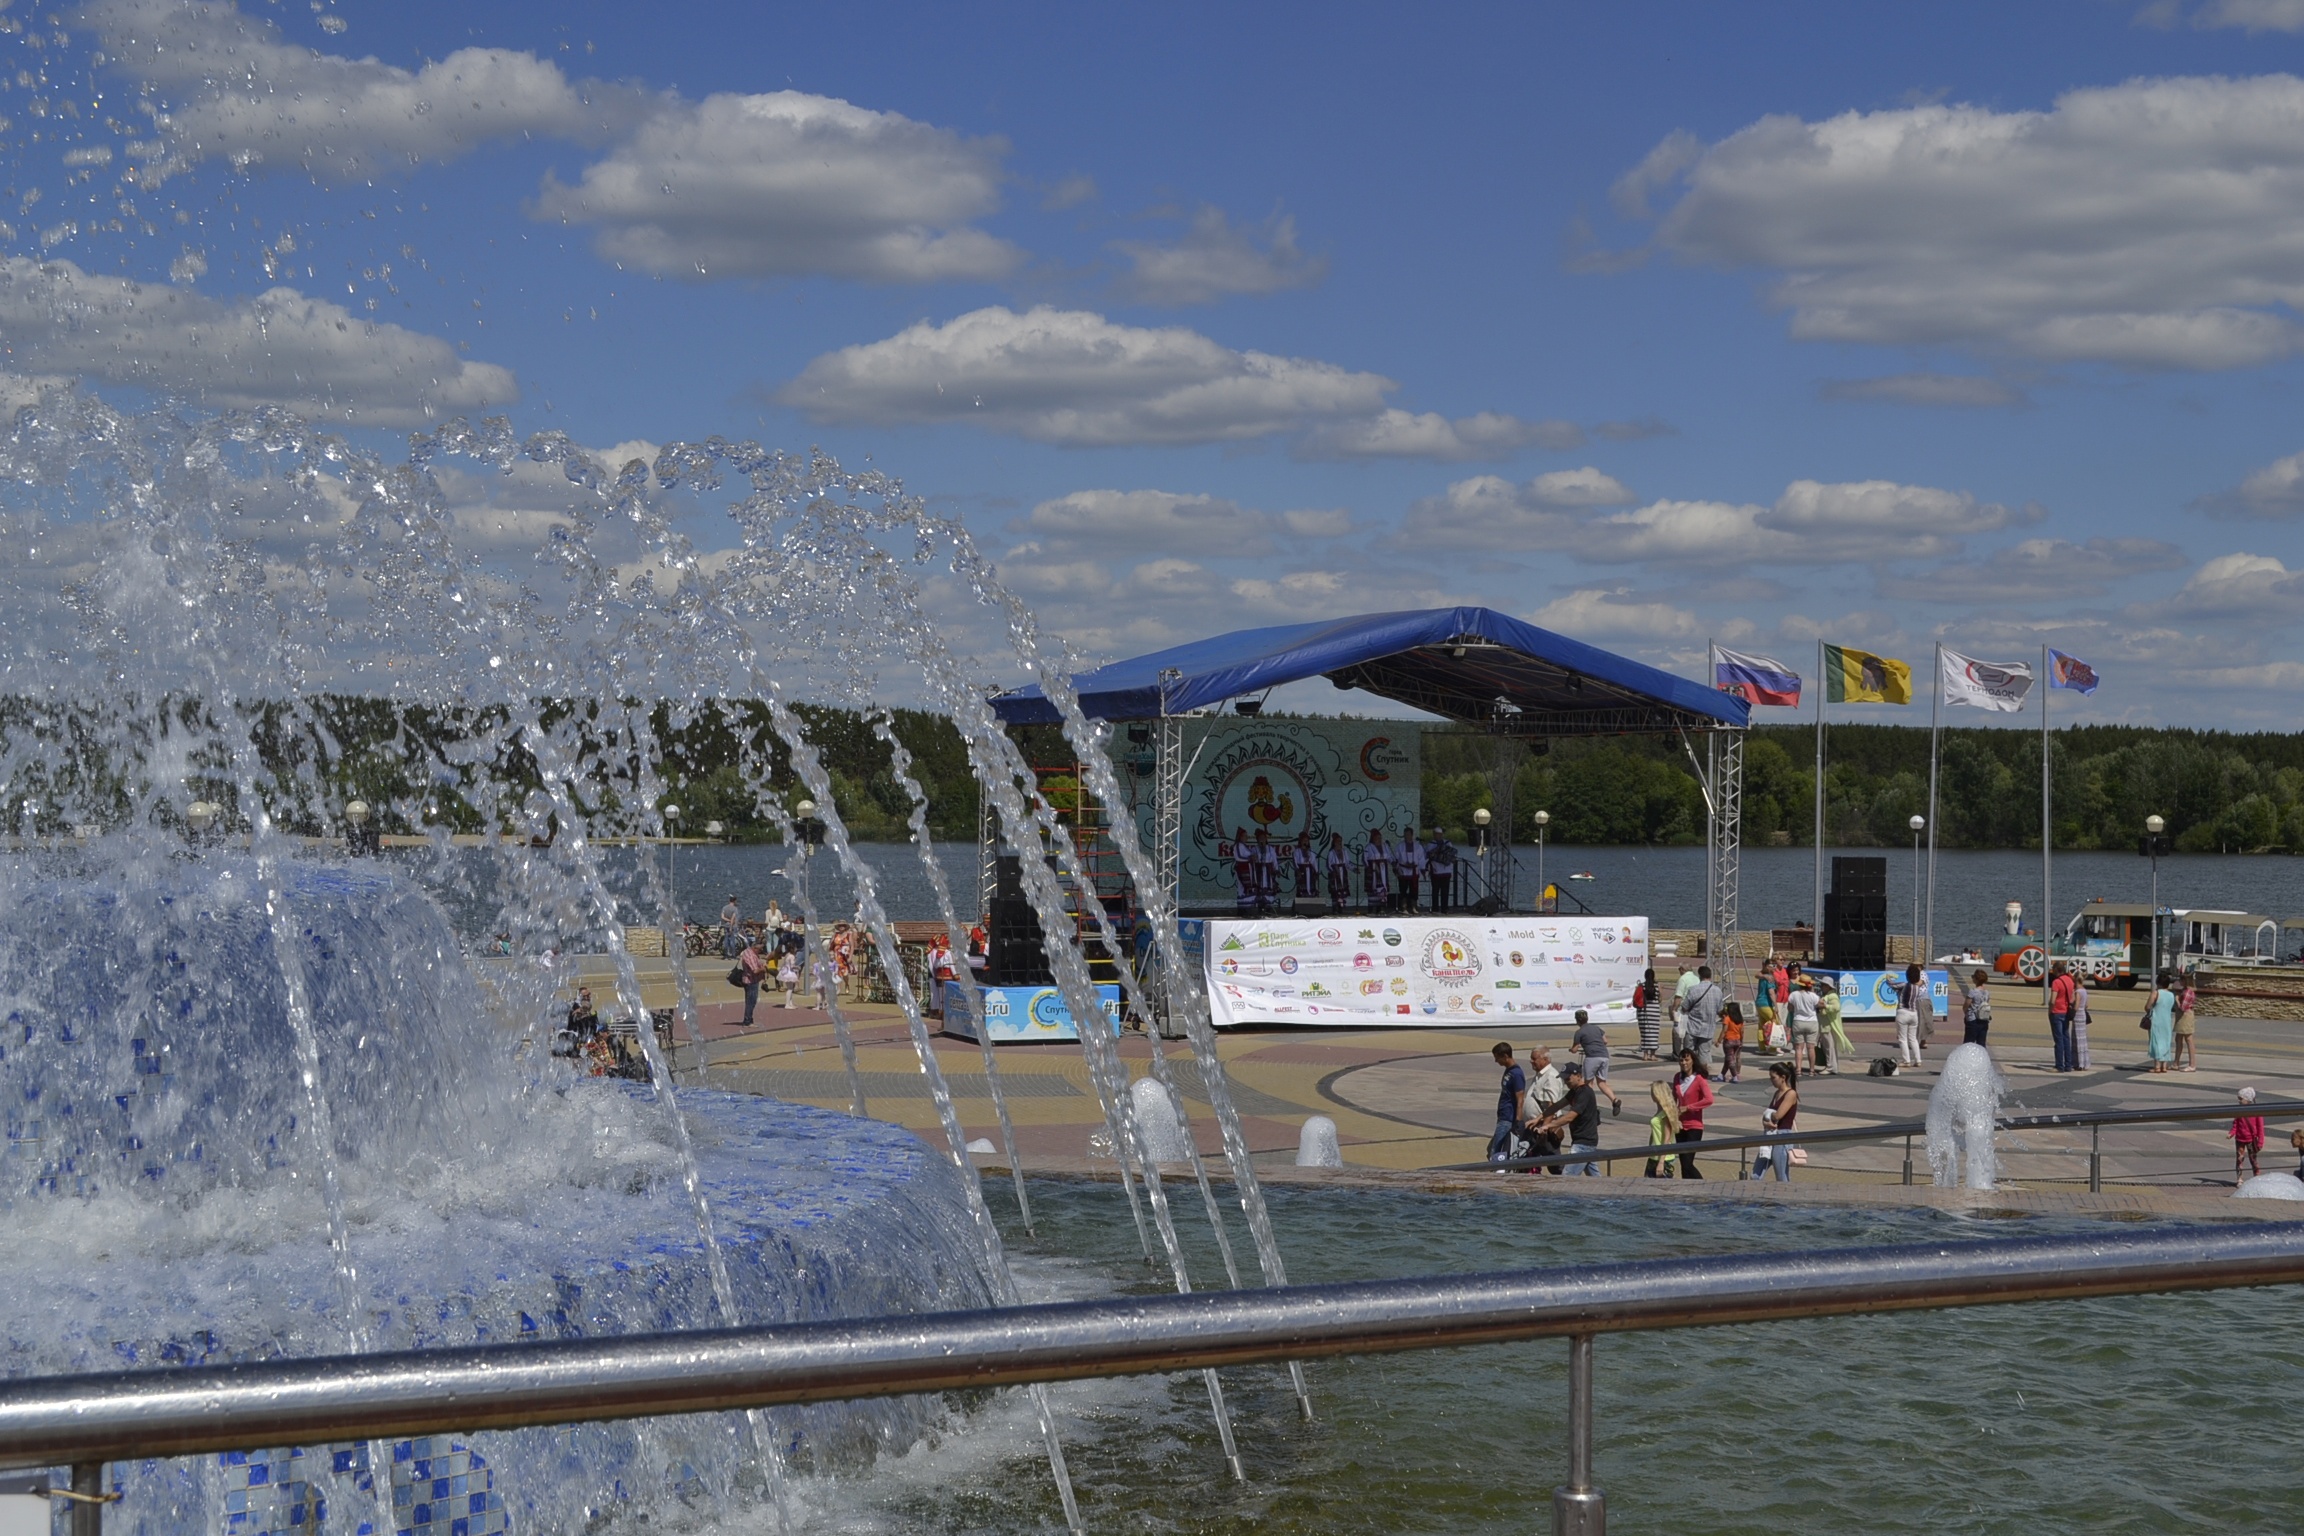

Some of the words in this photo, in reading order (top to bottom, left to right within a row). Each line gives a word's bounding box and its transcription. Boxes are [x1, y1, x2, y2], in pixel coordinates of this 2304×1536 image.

[1965, 684, 2015, 698] ТЕРМОДОМ
[1245, 732, 1276, 741] фестиваль
[1276, 733, 1306, 752] творчества
[1376, 754, 1409, 765] Спутник
[1270, 932, 1290, 941] Парк
[1507, 930, 1535, 939] iMold
[1270, 939, 1307, 949] Спутника
[1301, 989, 1332, 997] РИТЭЙЛ
